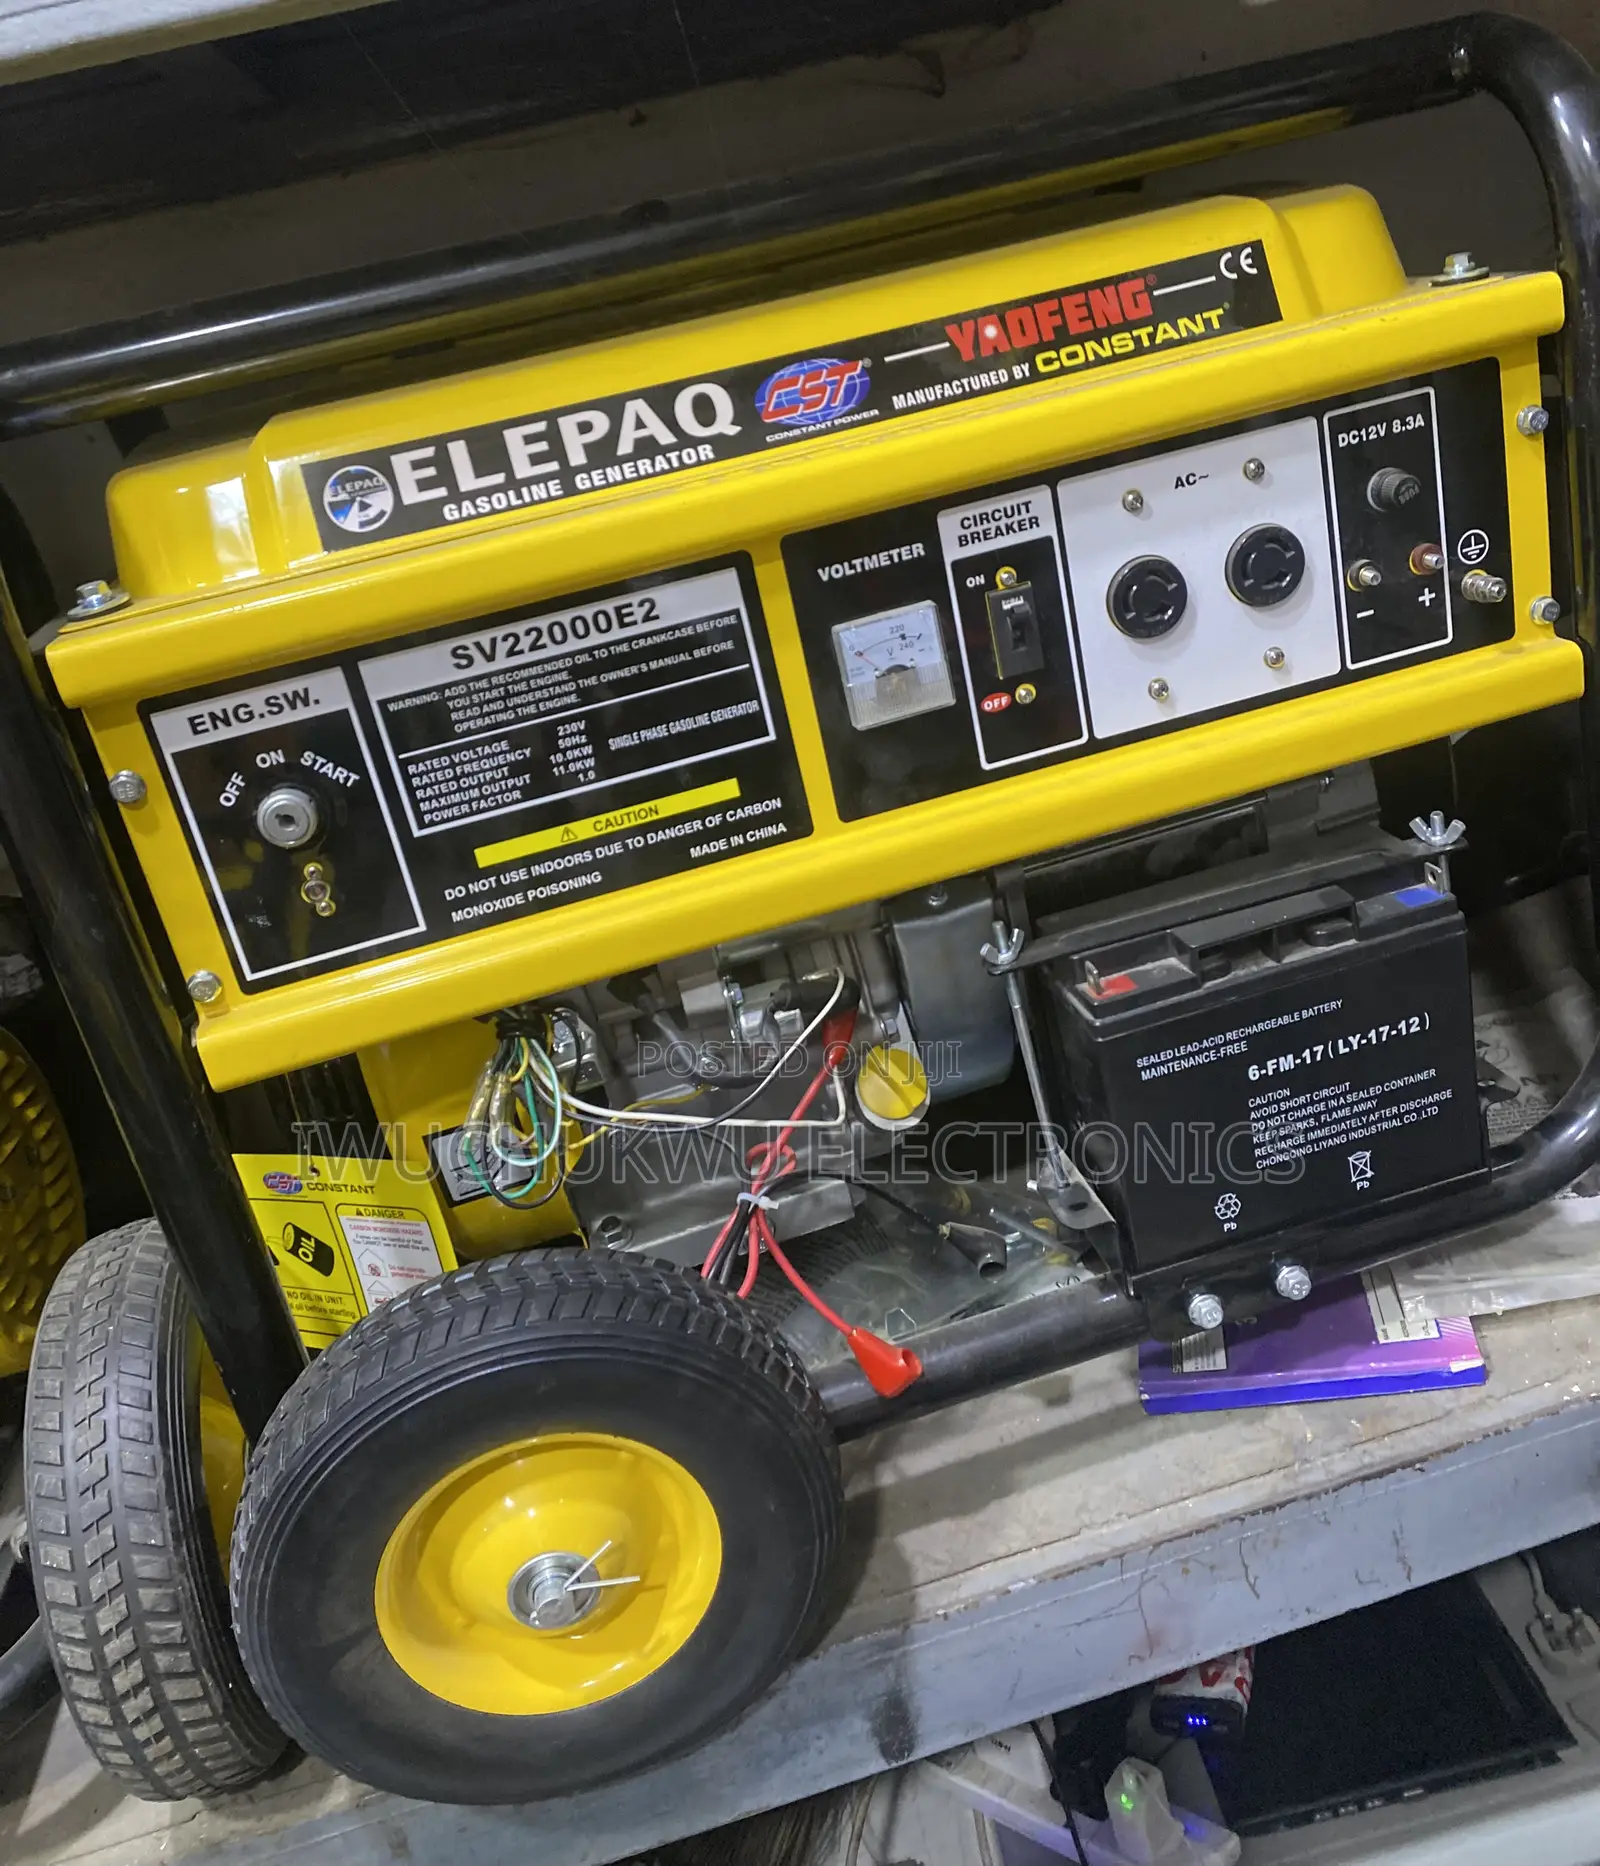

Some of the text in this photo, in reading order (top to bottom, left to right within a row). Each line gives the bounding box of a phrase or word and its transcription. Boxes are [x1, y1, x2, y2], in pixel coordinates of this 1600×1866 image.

[945, 278, 1153, 361] YAOFENG
[892, 308, 1224, 410] MANUFACTURED BY CONSTANT
[761, 361, 863, 424] CST
[766, 408, 879, 442] CONSTANT POWER
[1338, 413, 1425, 448] DC12V 8.3A
[390, 382, 743, 506] ELEPAQ
[443, 444, 716, 521] GASOLINE GENERATOR
[958, 515, 1040, 548] BREAKER
[960, 500, 1032, 530] CIRCUIT
[817, 542, 925, 582] VOLTMETER
[965, 574, 985, 588] ON
[449, 597, 660, 671] SV22000E2
[889, 624, 905, 635] 220
[898, 639, 915, 651] 240
[387, 615, 737, 711] WARNING: ADD THE RECOMMENDED OIL TO THE CRANKCASE BEFORE
[450, 640, 734, 720] READ AND UNDERSTAND THE OWNER'S MANUAL BEFORE
[446, 671, 571, 709] YOU START THE ENGINE.
[983, 695, 1009, 711] OFF
[188, 687, 320, 736] ENG.SW.
[454, 693, 580, 732] OPERATING THE ENGINE.
[557, 720, 585, 736] 230V
[608, 700, 759, 750] SINGLE PHASE GASOLINE GENERATOR
[255, 748, 285, 769] ON
[407, 740, 509, 774] RATED VOLTAGE
[549, 745, 592, 763] 10.0KW
[558, 735, 587, 748] 50Hz
[300, 750, 360, 789] START
[412, 747, 530, 787] RATED FREQUENCY
[415, 766, 508, 799] RATED OUTPUT
[553, 757, 594, 776] 11.0KW
[578, 770, 595, 781] 1.0
[219, 771, 246, 808] OFF
[419, 774, 530, 811] MAXIMUM OUTPUT
[423, 790, 521, 823] POWER FACTOR
[593, 805, 659, 831] CAUTION
[444, 797, 781, 900] DO NOT USE INDOORS DUE TO DANGER OF CARBON
[690, 823, 787, 857] MADE IN CHINA
[451, 871, 601, 922] MONOXIDE POISONING
[1136, 999, 1342, 1067] SEALED LEAD-ACID RECHARGEABLE BATTERY
[1141, 1041, 1247, 1080] MAINTENANCE-FREE
[1248, 1088, 1290, 1107] CAUTION
[1250, 1082, 1350, 1120] AVOID SHORT CIRCUIT
[1251, 1068, 1436, 1132] DO NOT CHARGE IN A SEALED CONTAINER
[1253, 1099, 1377, 1144] KEEP SPARKS, FLAME AWAY
[1254, 1089, 1452, 1157] RECHARGE IMMEDIATELY AFTER DISCHARGE
[1314, 1134, 1347, 1151] LIYANG
[1348, 1118, 1402, 1140] INDUSTRIAL
[306, 1182, 376, 1195] CONSTANT
[1356, 1180, 1370, 1191] Pb
[364, 1207, 405, 1219] DANGER
[1224, 1221, 1237, 1232] Pb
[298, 1237, 316, 1263] OIL
